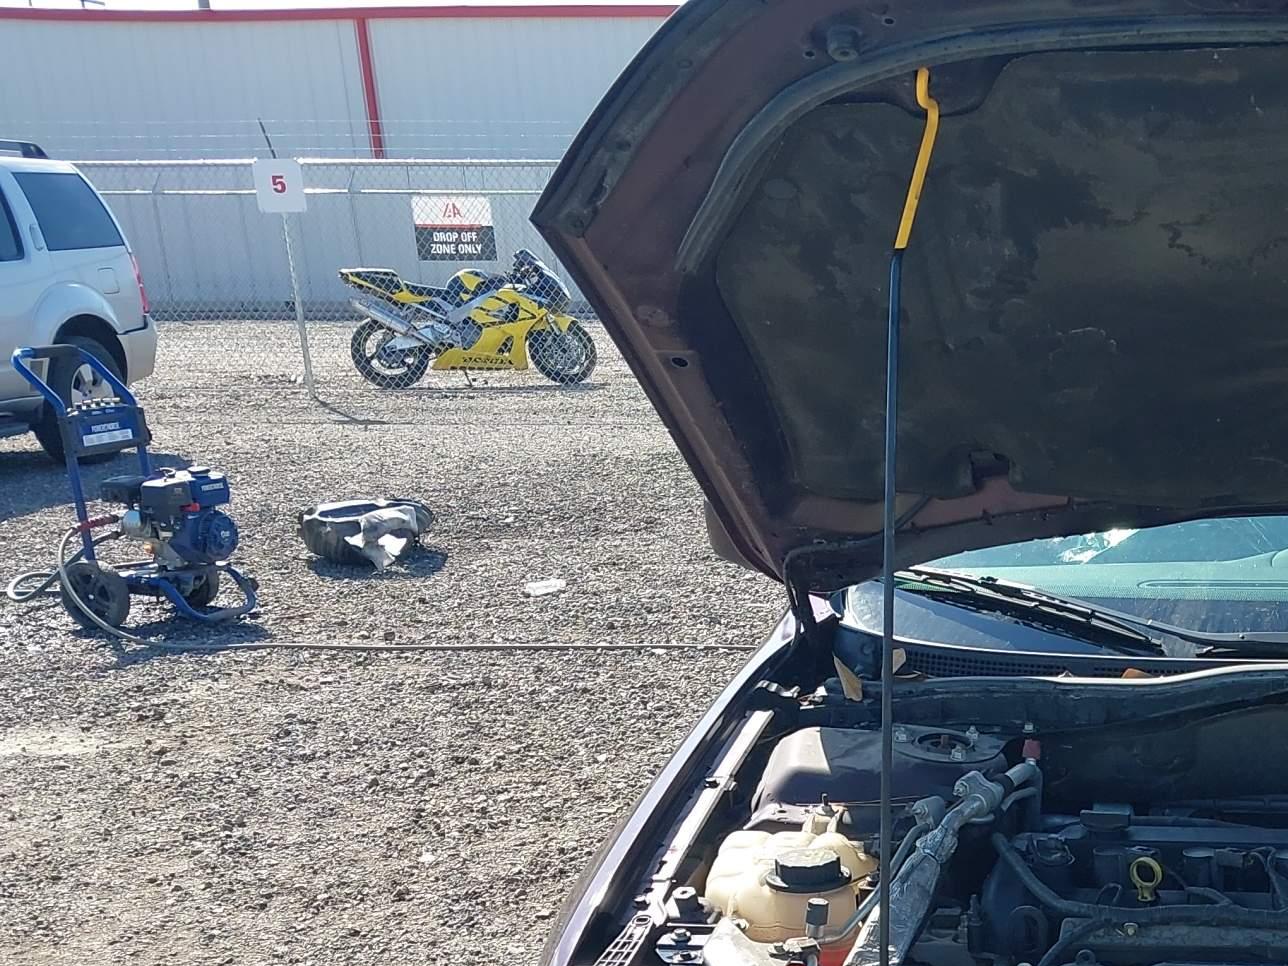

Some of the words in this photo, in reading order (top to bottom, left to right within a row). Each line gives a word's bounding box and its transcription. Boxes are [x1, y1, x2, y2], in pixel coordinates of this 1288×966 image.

[271, 175, 287, 194] 5
[433, 231, 458, 242] DROP
[460, 231, 478, 242] OFF
[430, 243, 456, 254] ZONE
[458, 243, 482, 254] ONLY
